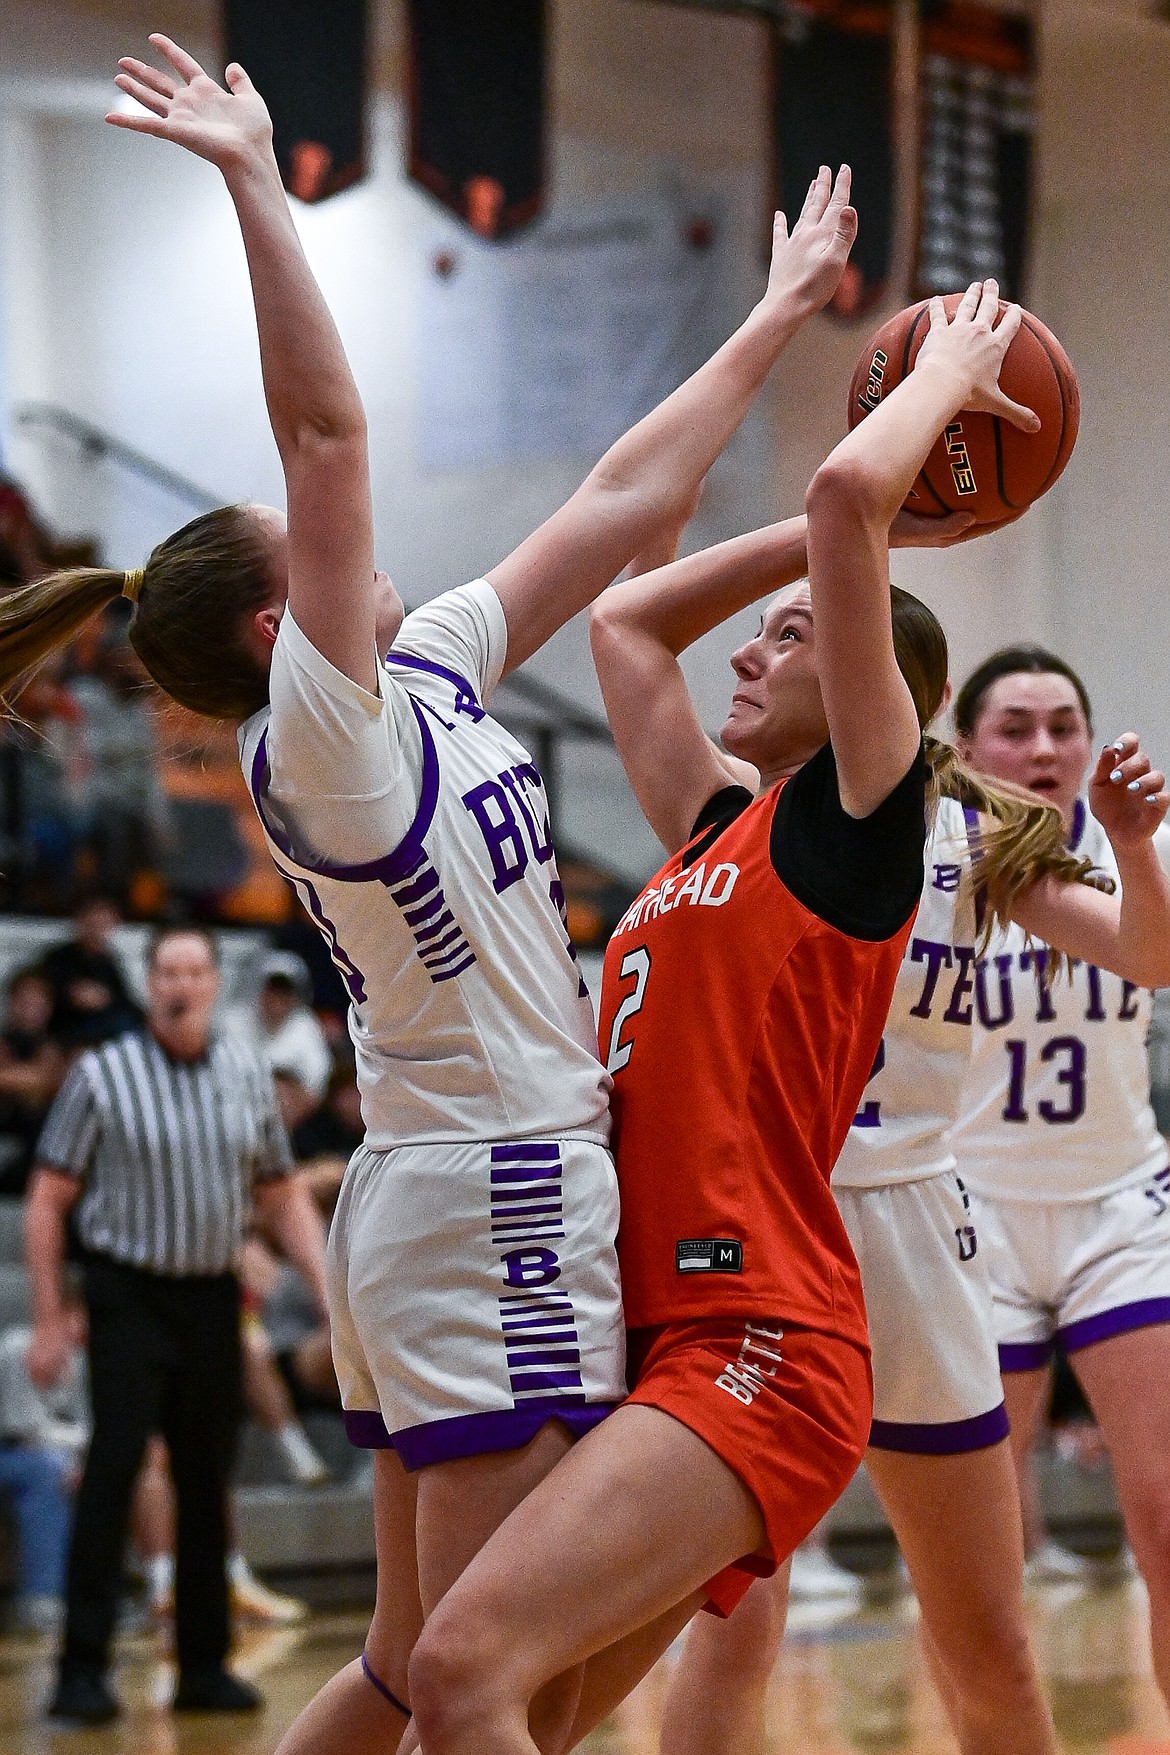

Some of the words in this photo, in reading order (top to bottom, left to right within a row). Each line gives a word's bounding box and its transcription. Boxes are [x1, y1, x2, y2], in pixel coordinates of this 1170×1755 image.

[606, 944, 652, 1075] 2
[1002, 1036, 1087, 1124] 13
[500, 1247, 562, 1288] B
[720, 1249, 733, 1262] M
